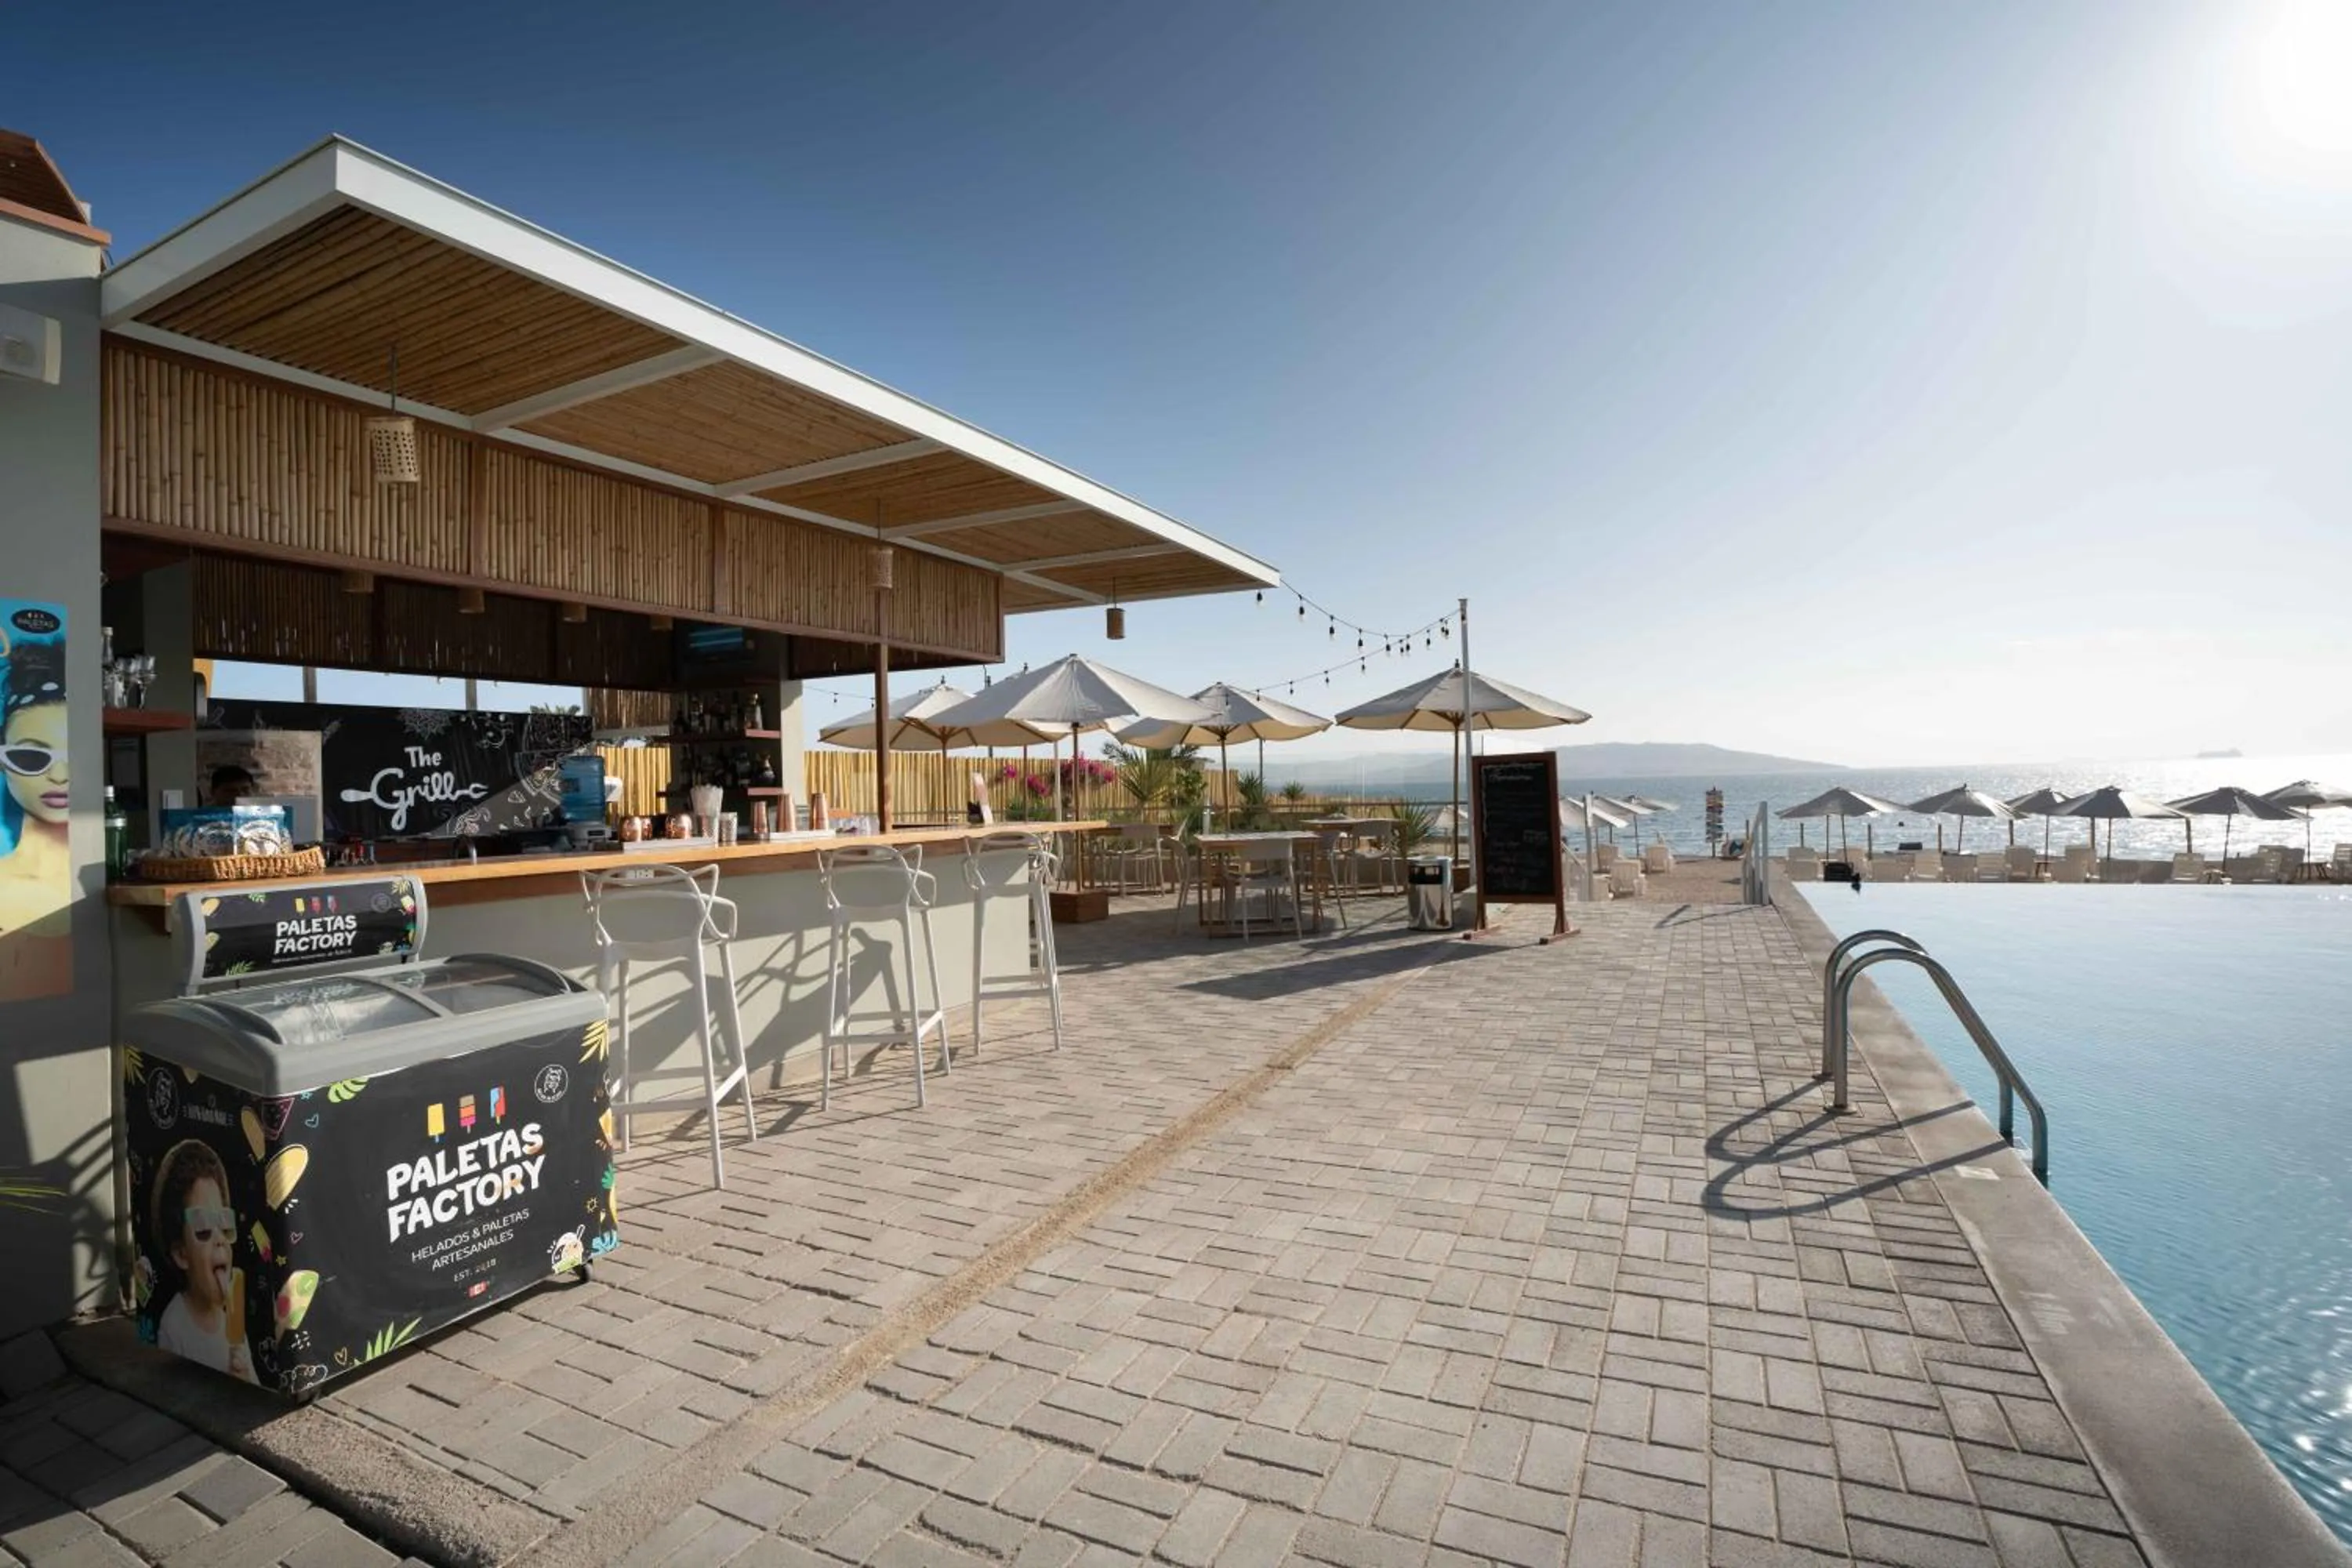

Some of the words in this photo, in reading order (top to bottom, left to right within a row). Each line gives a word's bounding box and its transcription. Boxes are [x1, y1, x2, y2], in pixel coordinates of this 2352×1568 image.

[404, 746, 442, 768] The
[370, 768, 469, 830] Grill
[274, 931, 357, 954] FACTORY
[276, 915, 358, 937] PALETAS
[387, 1123, 544, 1201] PALETAS
[387, 1154, 546, 1243] FACTORY
[412, 1231, 470, 1263] HELADOS
[472, 1227, 481, 1240] &
[482, 1208, 530, 1236] PALETAS
[432, 1229, 514, 1271] ARTESANALES
